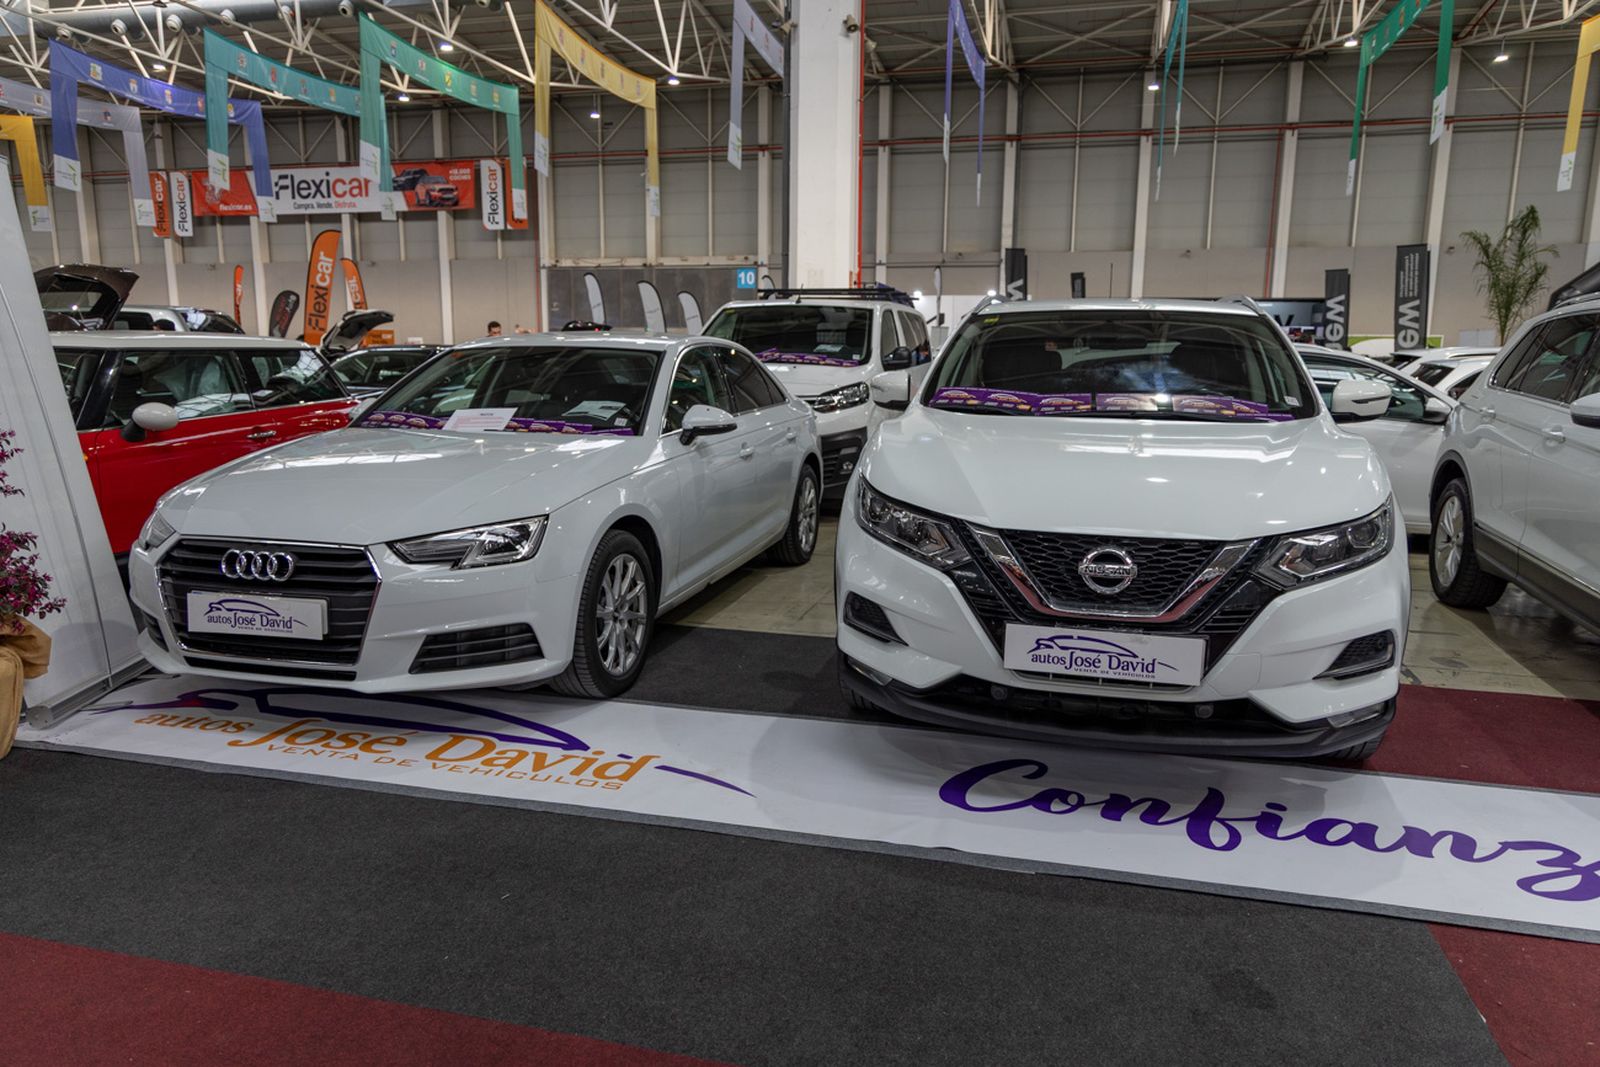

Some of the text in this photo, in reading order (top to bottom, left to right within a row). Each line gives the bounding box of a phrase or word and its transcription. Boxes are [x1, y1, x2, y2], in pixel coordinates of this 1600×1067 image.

[274, 171, 371, 200] Flexicar
[487, 166, 500, 225] Flexicar
[155, 178, 167, 233] Flexicar
[177, 177, 189, 233] Flexicar
[308, 251, 333, 331] Flexicar
[738, 271, 755, 285] 10
[1084, 565, 1131, 577] NISSAN
[260, 614, 293, 629] David
[1108, 654, 1157, 674] David
[134, 713, 662, 782] autos José David
[267, 744, 359, 761] VENTA
[373, 756, 420, 767] DE
